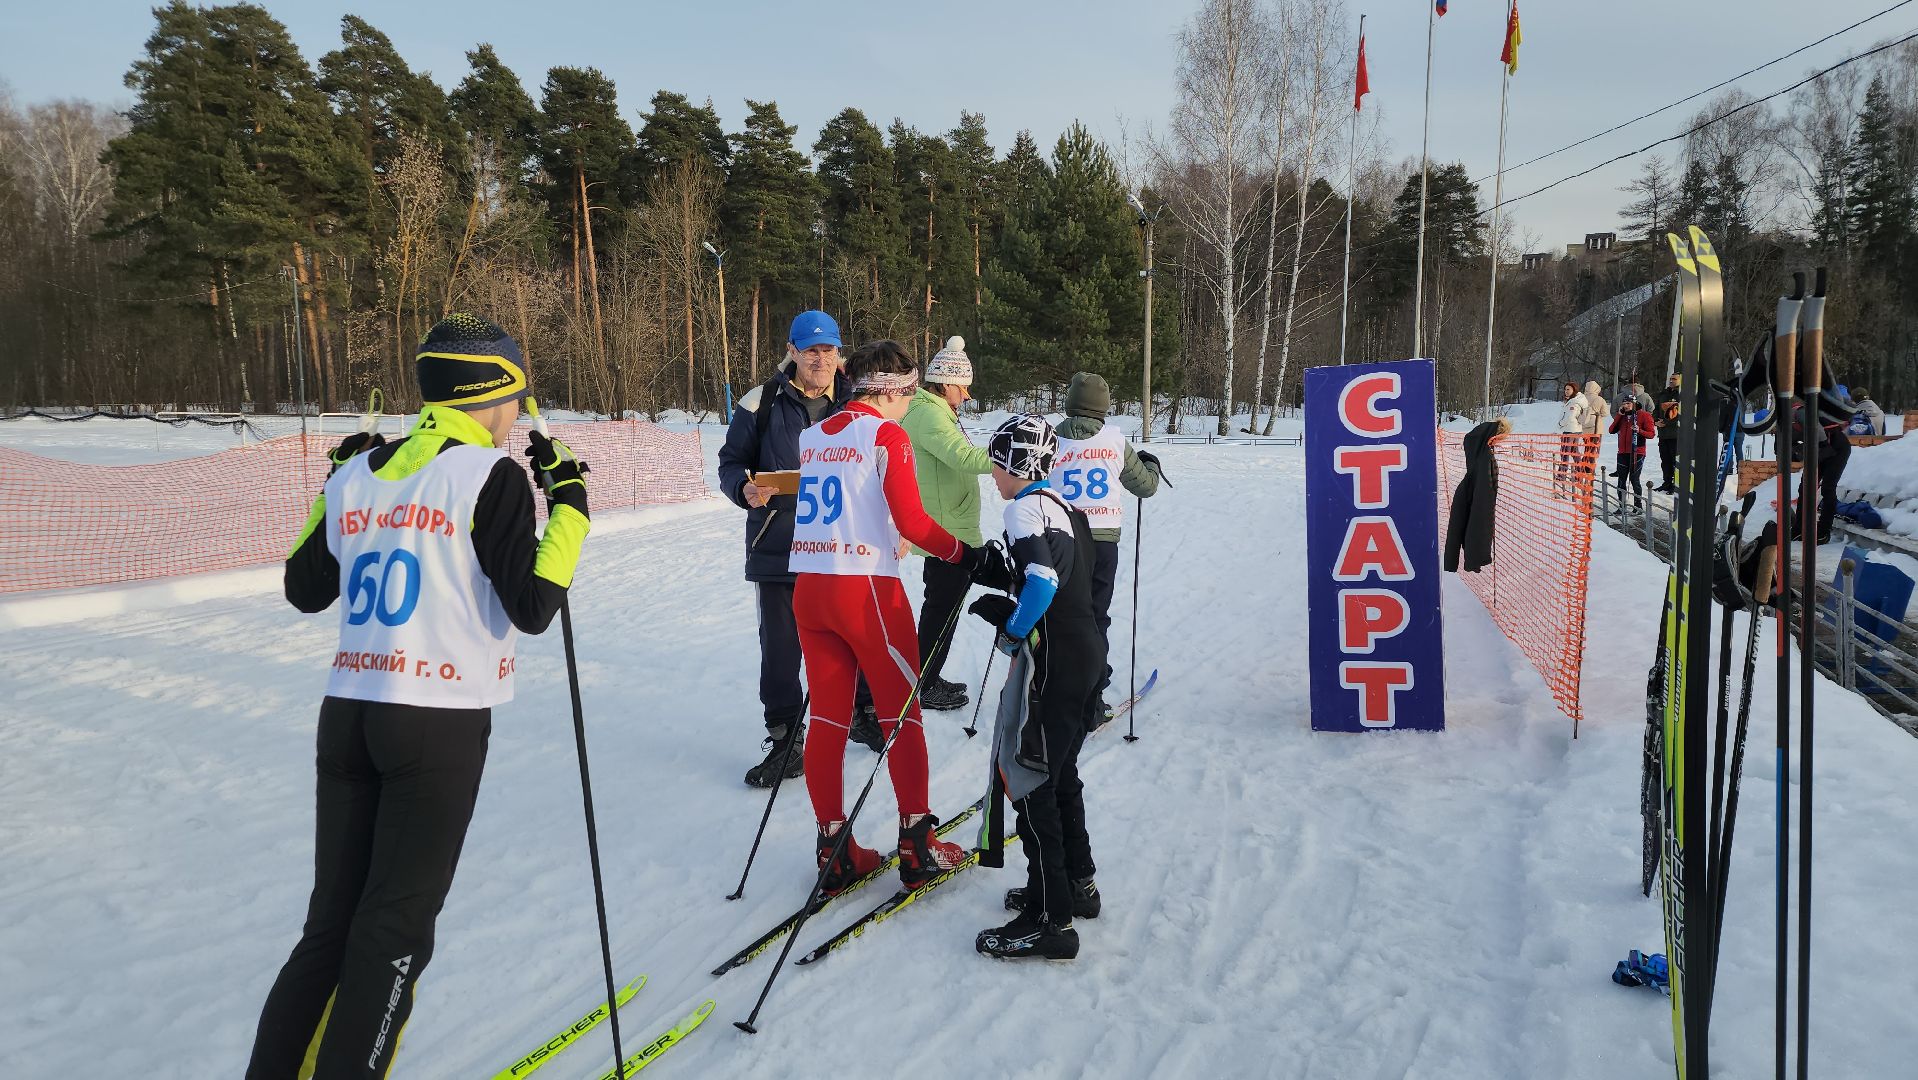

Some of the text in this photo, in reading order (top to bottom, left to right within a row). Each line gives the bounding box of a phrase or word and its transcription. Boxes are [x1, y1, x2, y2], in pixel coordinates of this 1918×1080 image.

[453, 379, 502, 393] FISCHER
[816, 446, 863, 463] «СШОР»
[797, 475, 843, 525] 59
[1061, 467, 1110, 501] 58
[1333, 371, 1415, 728] СТАРТ
[347, 547, 421, 627] 60
[415, 660, 431, 678] г.
[439, 662, 462, 681] о.
[914, 856, 975, 900] FISCHER
[368, 974, 406, 1070] FISCHER
[510, 1008, 606, 1076] FISCHER
